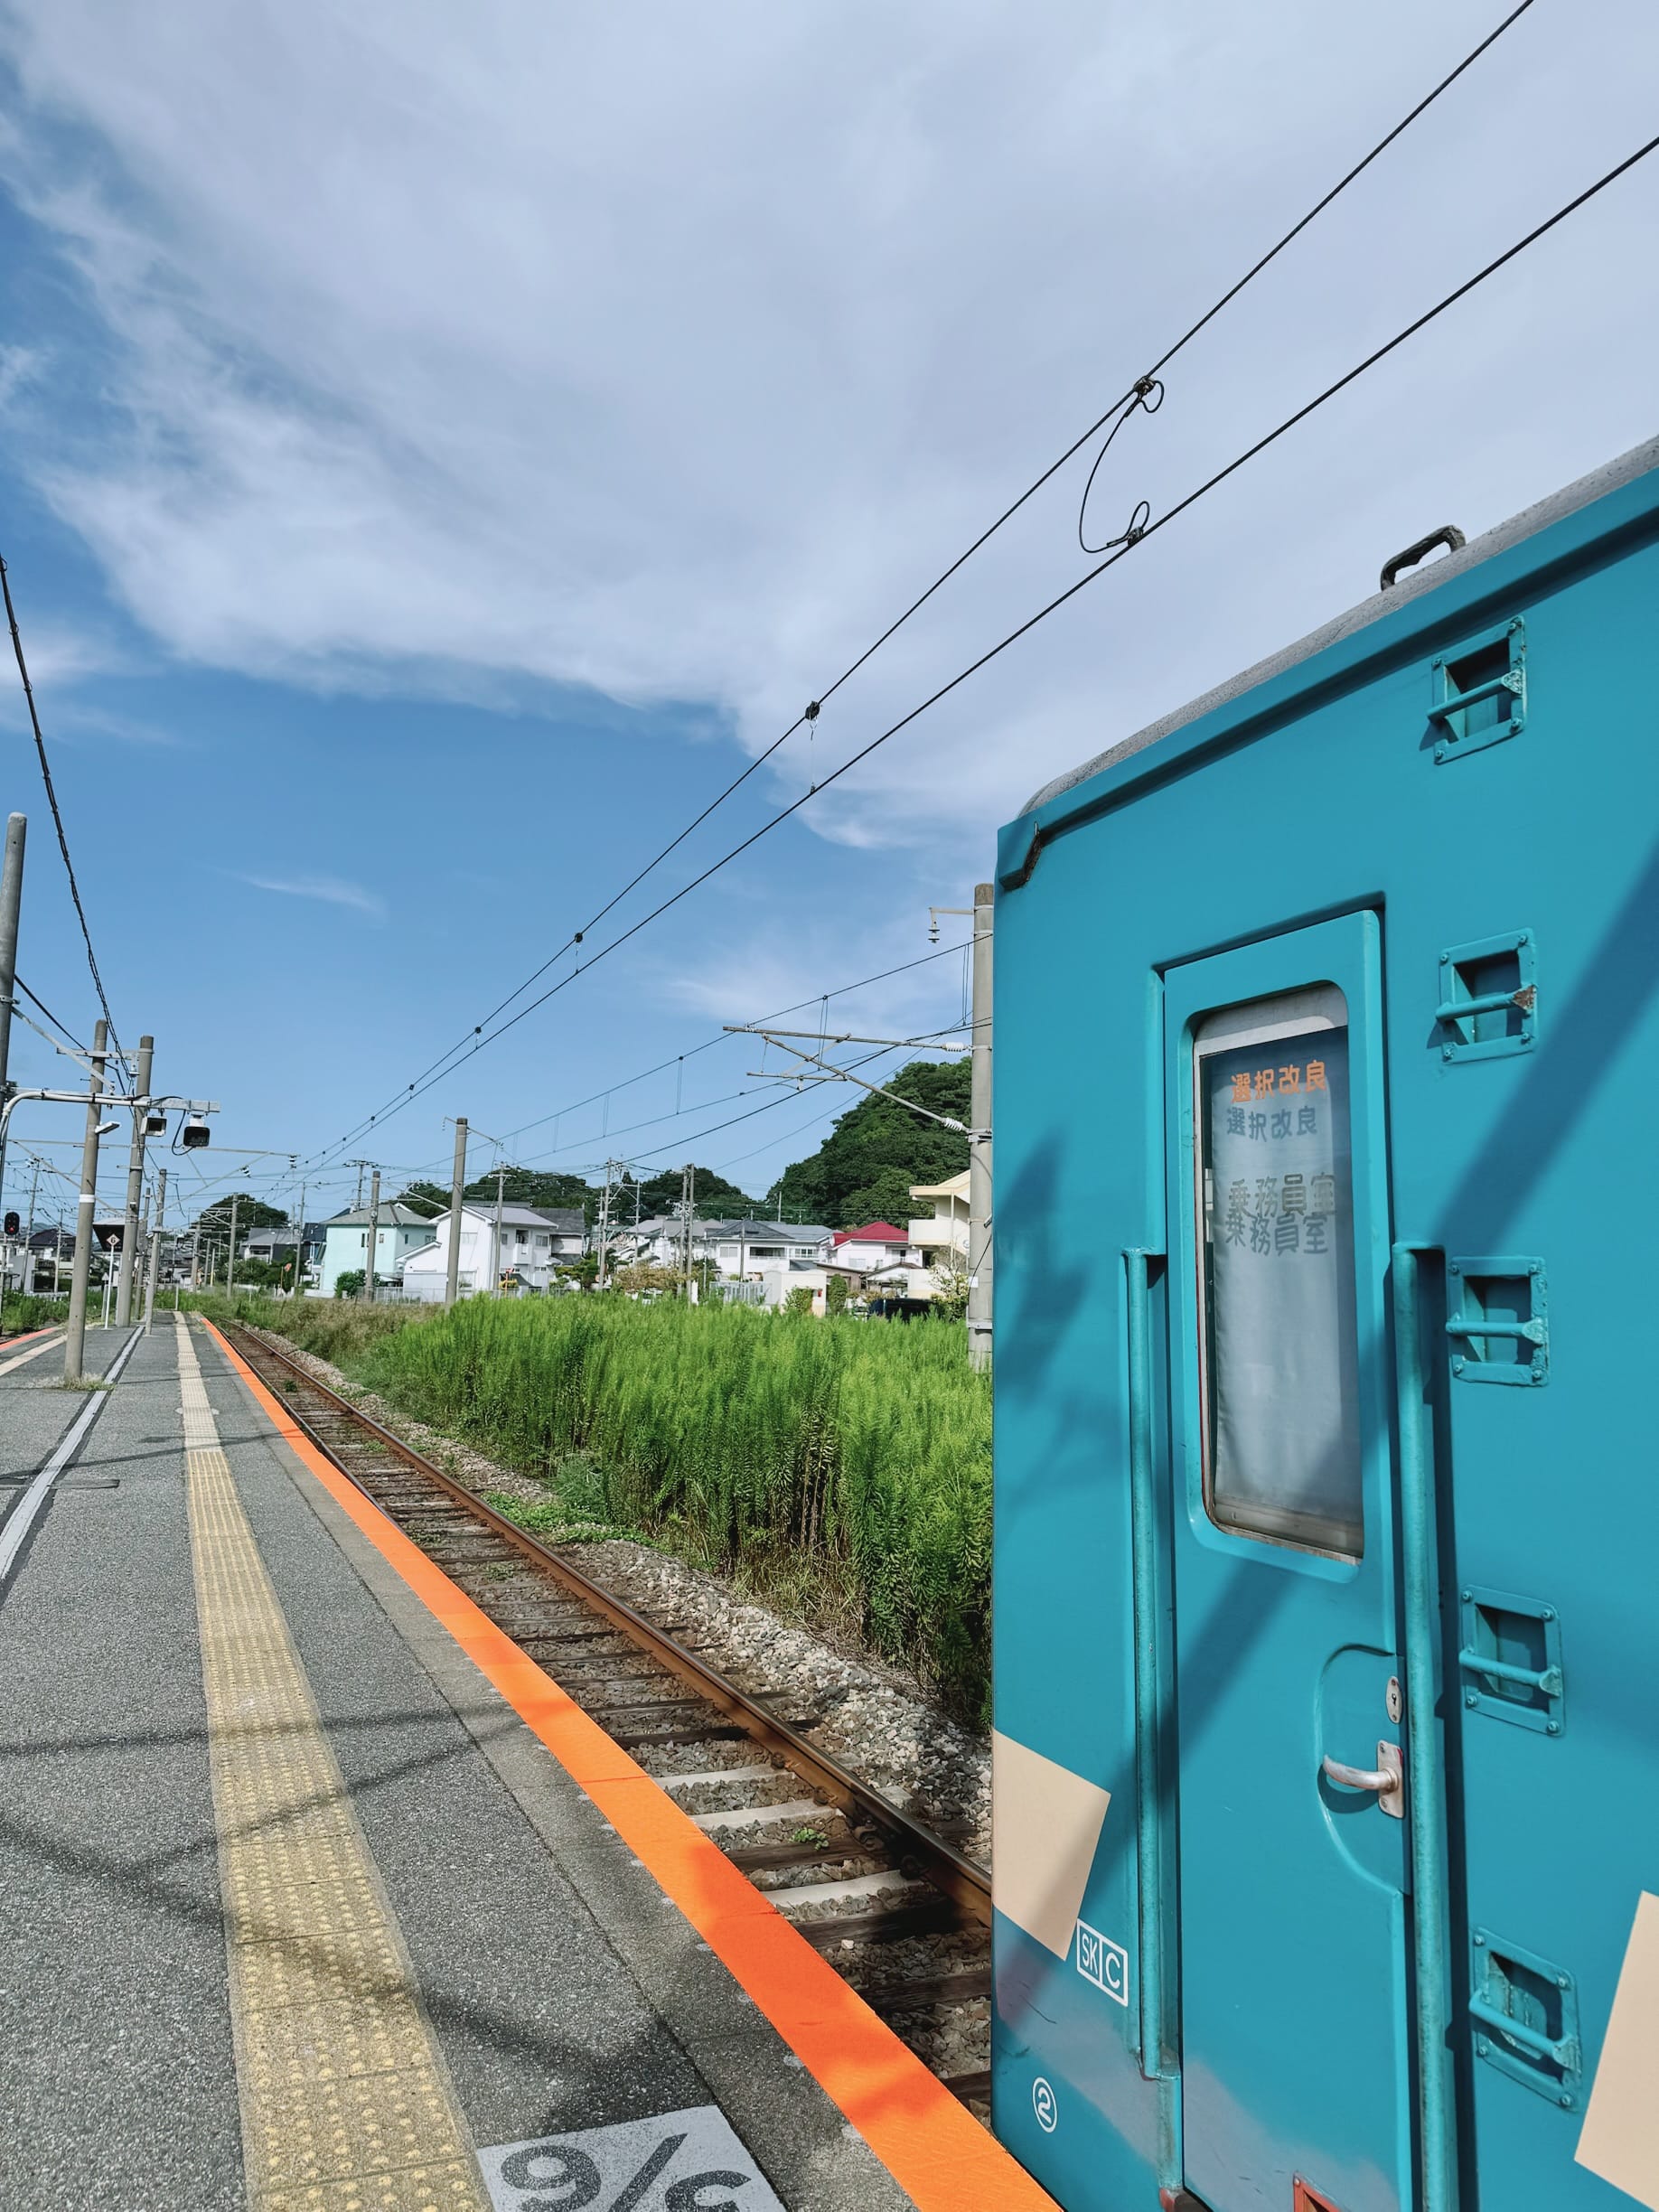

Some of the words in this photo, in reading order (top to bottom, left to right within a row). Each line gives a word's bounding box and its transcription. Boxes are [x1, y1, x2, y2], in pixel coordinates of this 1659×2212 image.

[1230, 1059, 1327, 1103] 選択改良
[1228, 1172, 1336, 1218] 乗務員室
